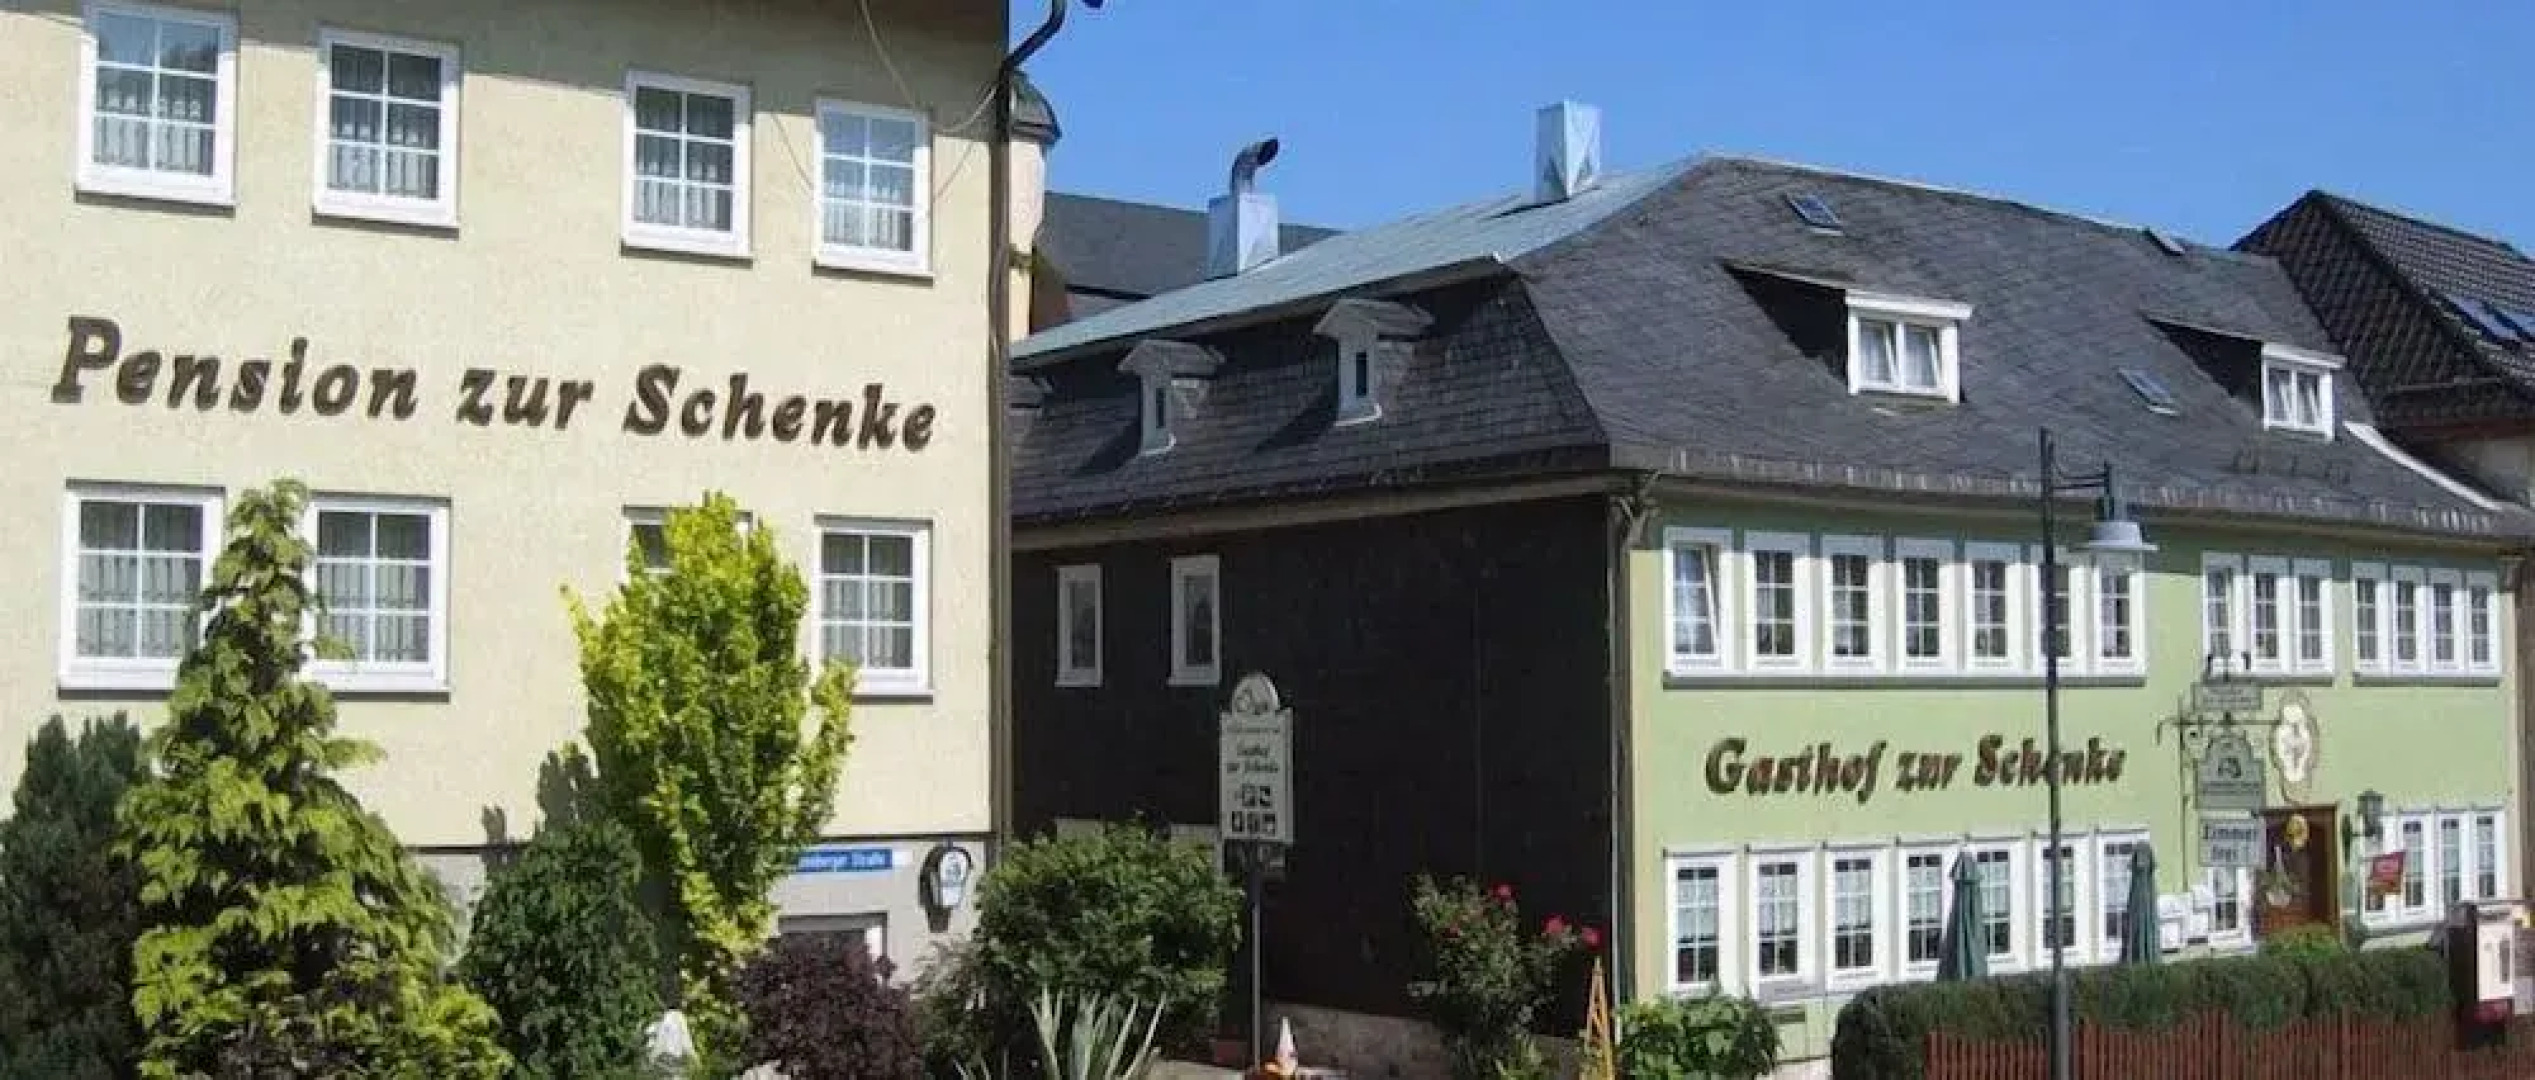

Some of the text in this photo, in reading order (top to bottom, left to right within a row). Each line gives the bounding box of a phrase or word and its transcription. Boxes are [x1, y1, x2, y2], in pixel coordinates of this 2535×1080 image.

[51, 315, 937, 453] Pension zur Schenke
[1704, 733, 2127, 804] Gasthof zur Schenke
